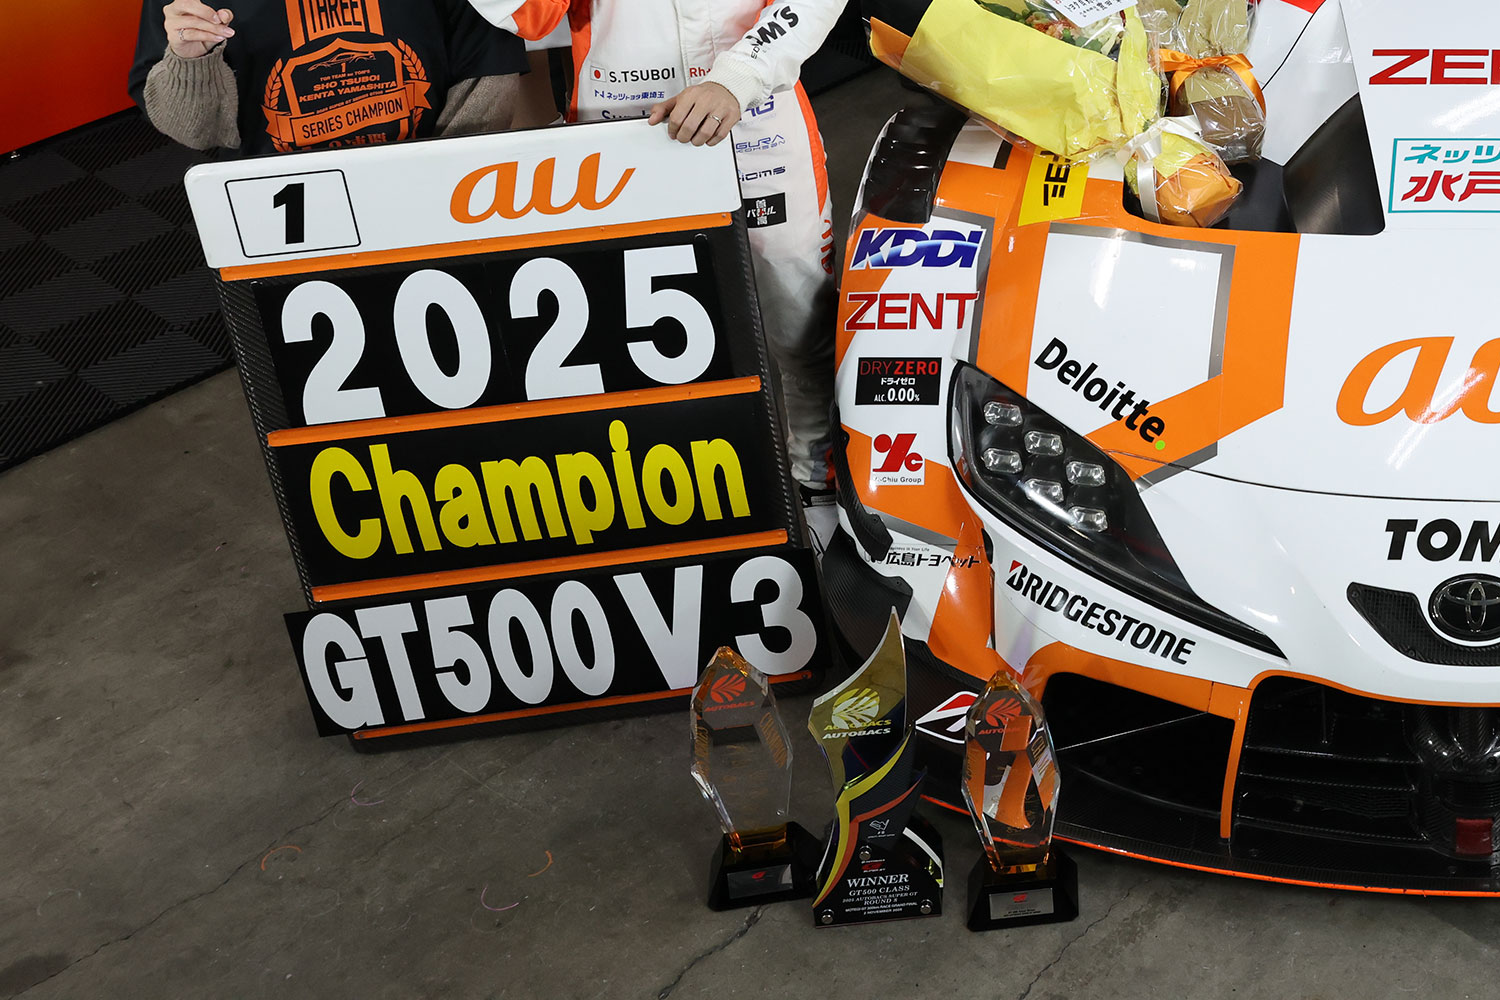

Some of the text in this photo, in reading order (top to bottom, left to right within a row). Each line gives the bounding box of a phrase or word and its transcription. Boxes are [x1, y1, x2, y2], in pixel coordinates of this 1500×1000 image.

[313, 75, 380, 91] SHO TSUBOI
[609, 67, 676, 83] S.TSUBOI
[299, 90, 335, 103] KENTA
[338, 81, 398, 95] YAMASHITA
[302, 115, 343, 139] SERIES
[345, 97, 403, 126] CHAMPION
[450, 151, 637, 225] au
[272, 182, 305, 245] 1
[849, 228, 983, 269] KDDI
[846, 291, 979, 332] ZENT
[281, 244, 716, 426] 2025
[880, 377, 916, 385] ドライゼロ
[887, 387, 920, 402] 0.00%
[1034, 337, 1166, 450] Deloitte.
[309, 419, 751, 560] Champion
[900, 476, 922, 485] Group
[1005, 560, 1196, 665] BRIDGESTONE
[302, 579, 616, 730] GT500
[703, 701, 756, 712] AUTOBACS
[822, 727, 892, 740] AUTOBACS
[847, 873, 910, 888] WINNER
[848, 884, 910, 897] GT500 CLASS
